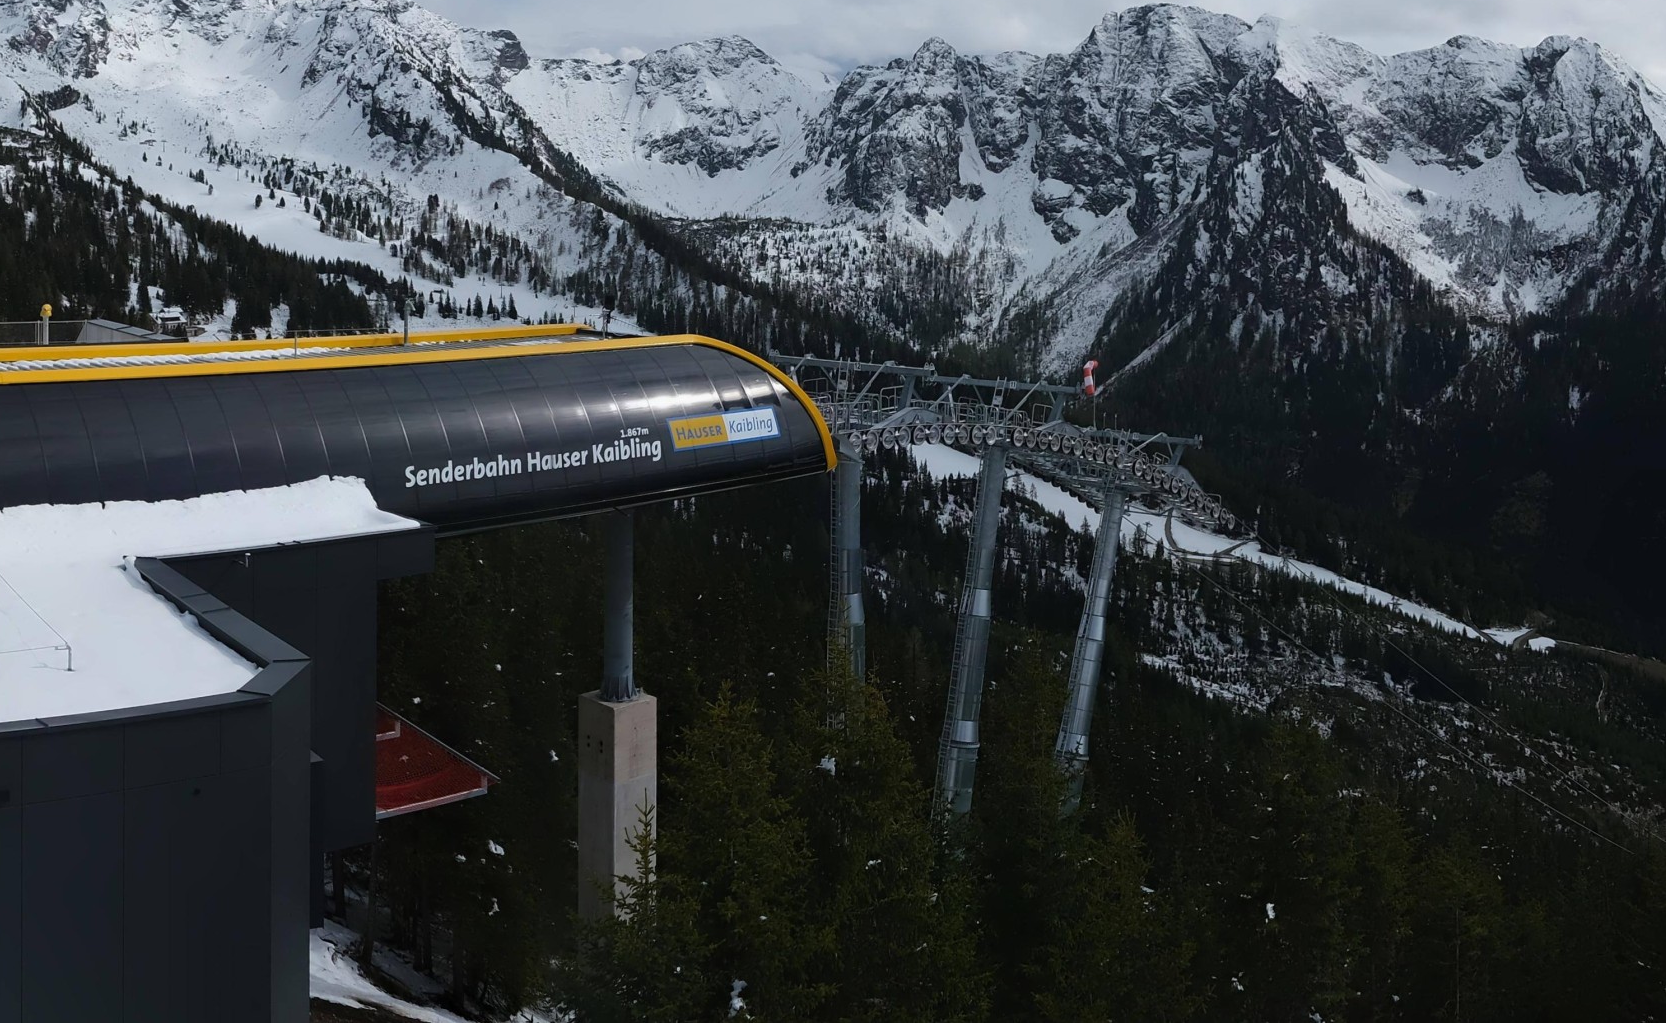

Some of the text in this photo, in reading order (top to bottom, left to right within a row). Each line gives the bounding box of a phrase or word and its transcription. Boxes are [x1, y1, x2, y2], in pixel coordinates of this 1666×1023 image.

[620, 427, 649, 438] 1.867m
[675, 417, 773, 441] HAUSER Kaibling
[404, 438, 662, 488] Senderbahn Hauser Kaibling
